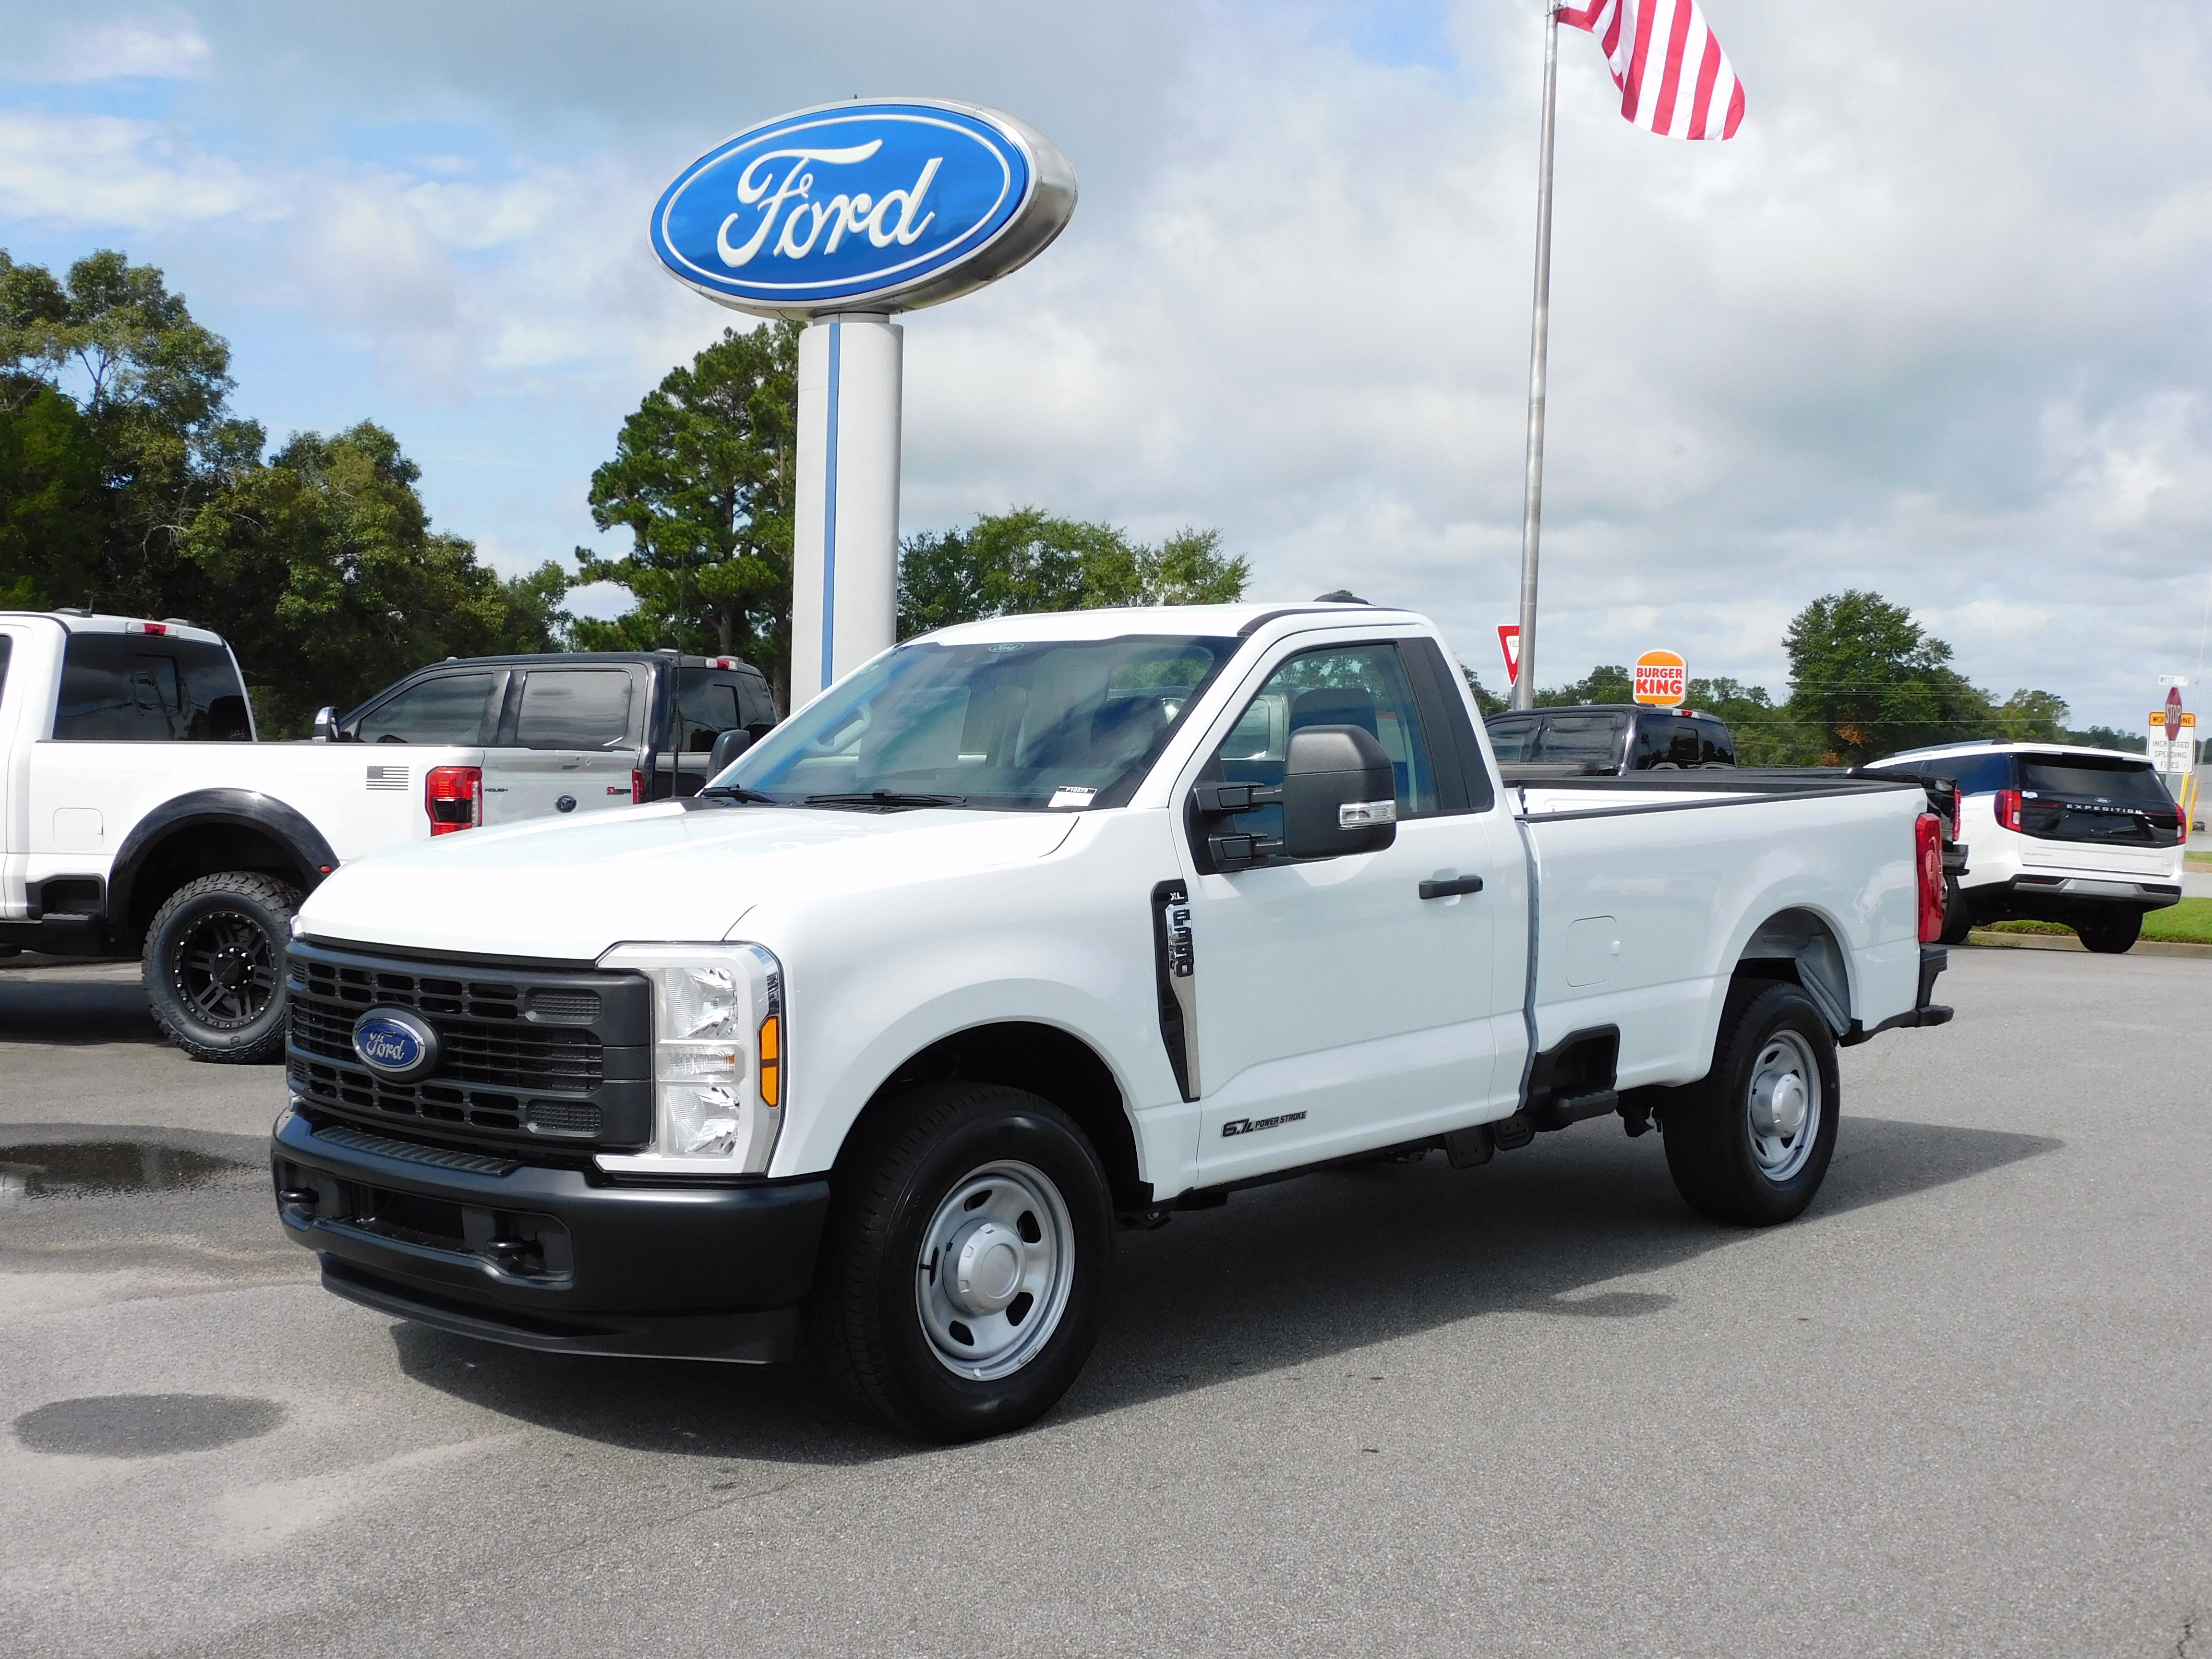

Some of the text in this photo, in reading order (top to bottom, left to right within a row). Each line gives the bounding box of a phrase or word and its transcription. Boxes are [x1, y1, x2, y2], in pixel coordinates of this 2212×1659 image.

[717, 139, 943, 268] Ford
[1636, 667, 1683, 679] BURGER
[1636, 679, 1682, 695] KING
[2166, 704, 2181, 724] STOP
[2067, 804, 2143, 815] EXPEDITION
[1169, 891, 1185, 901] XL
[366, 1028, 405, 1060] Ford
[1222, 1118, 1254, 1137] 6.7L
[1255, 1117, 1280, 1128] POWER
[1280, 1111, 1307, 1123] STROKE
